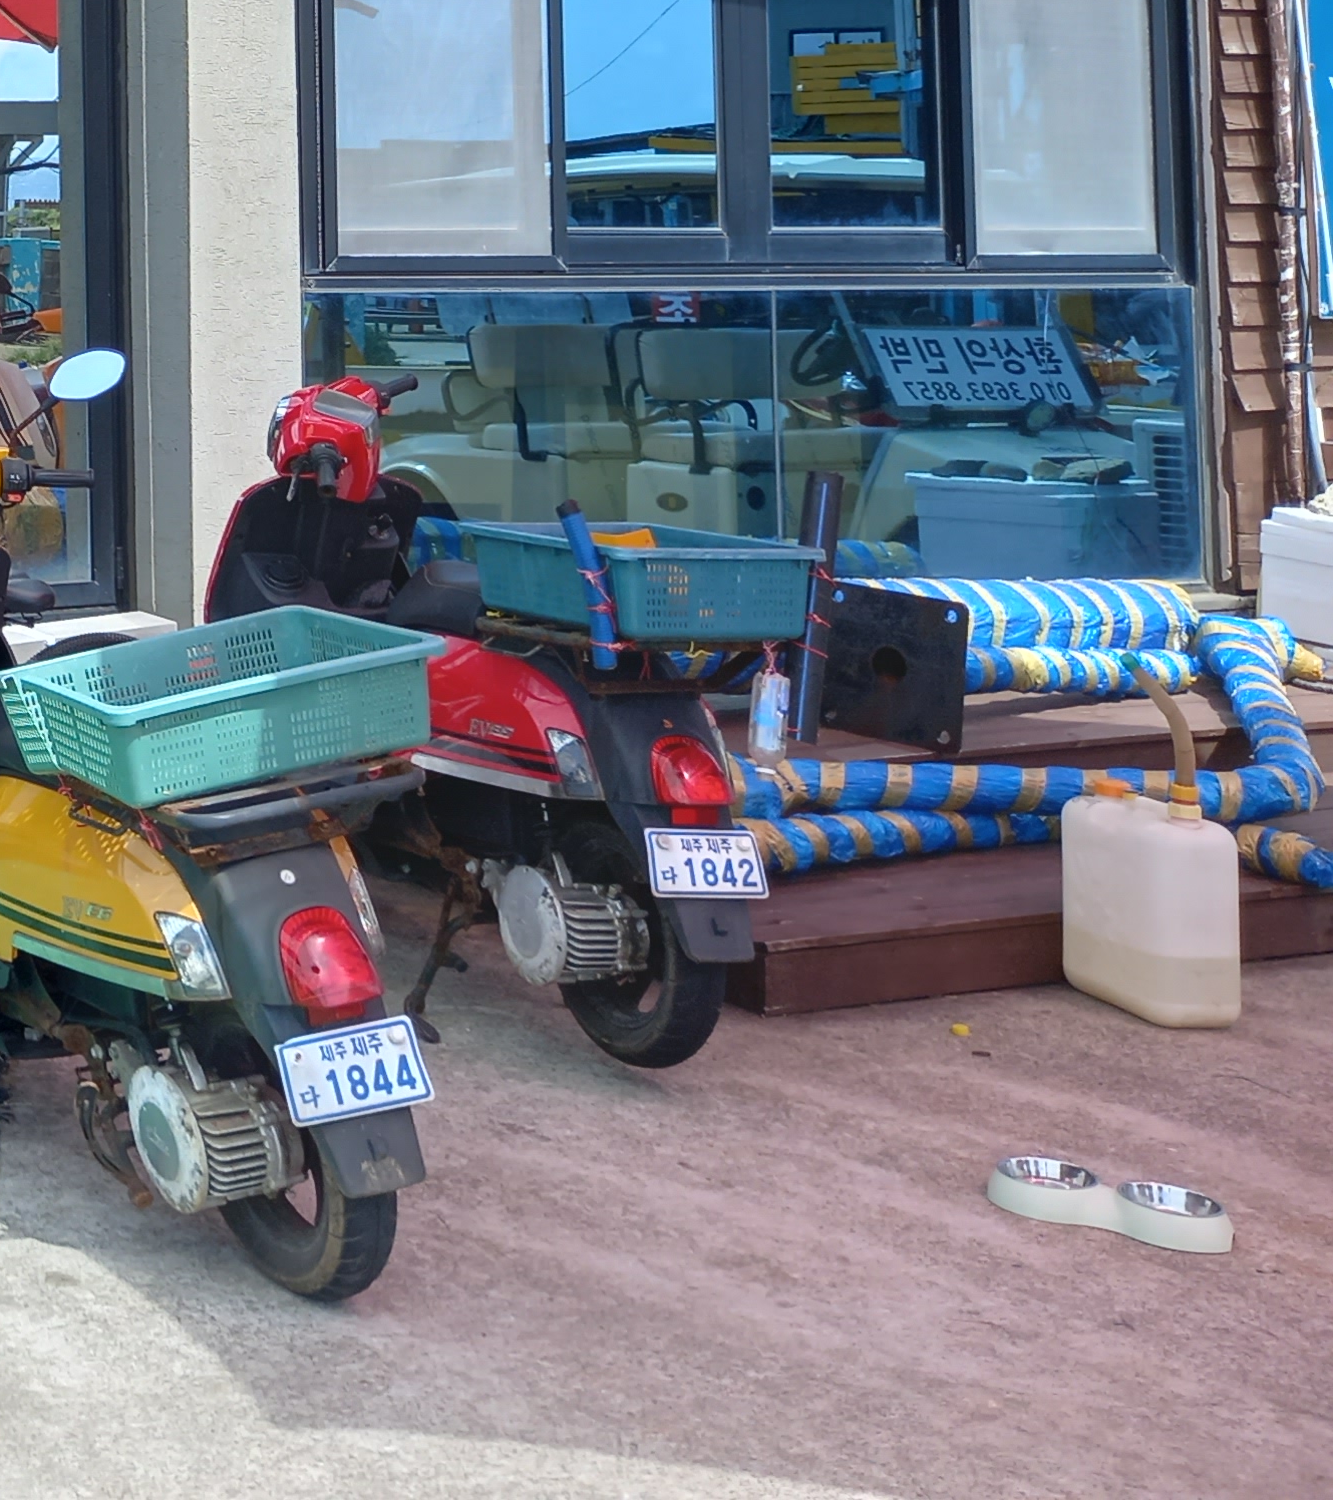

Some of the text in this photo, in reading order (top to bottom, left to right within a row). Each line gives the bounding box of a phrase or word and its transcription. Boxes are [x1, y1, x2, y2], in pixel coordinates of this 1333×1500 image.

[680, 836, 733, 855] 제주 제주
[661, 856, 759, 889] 다 1842
[320, 1031, 384, 1062] 제주 제주
[297, 1053, 418, 1109] 다 1844
